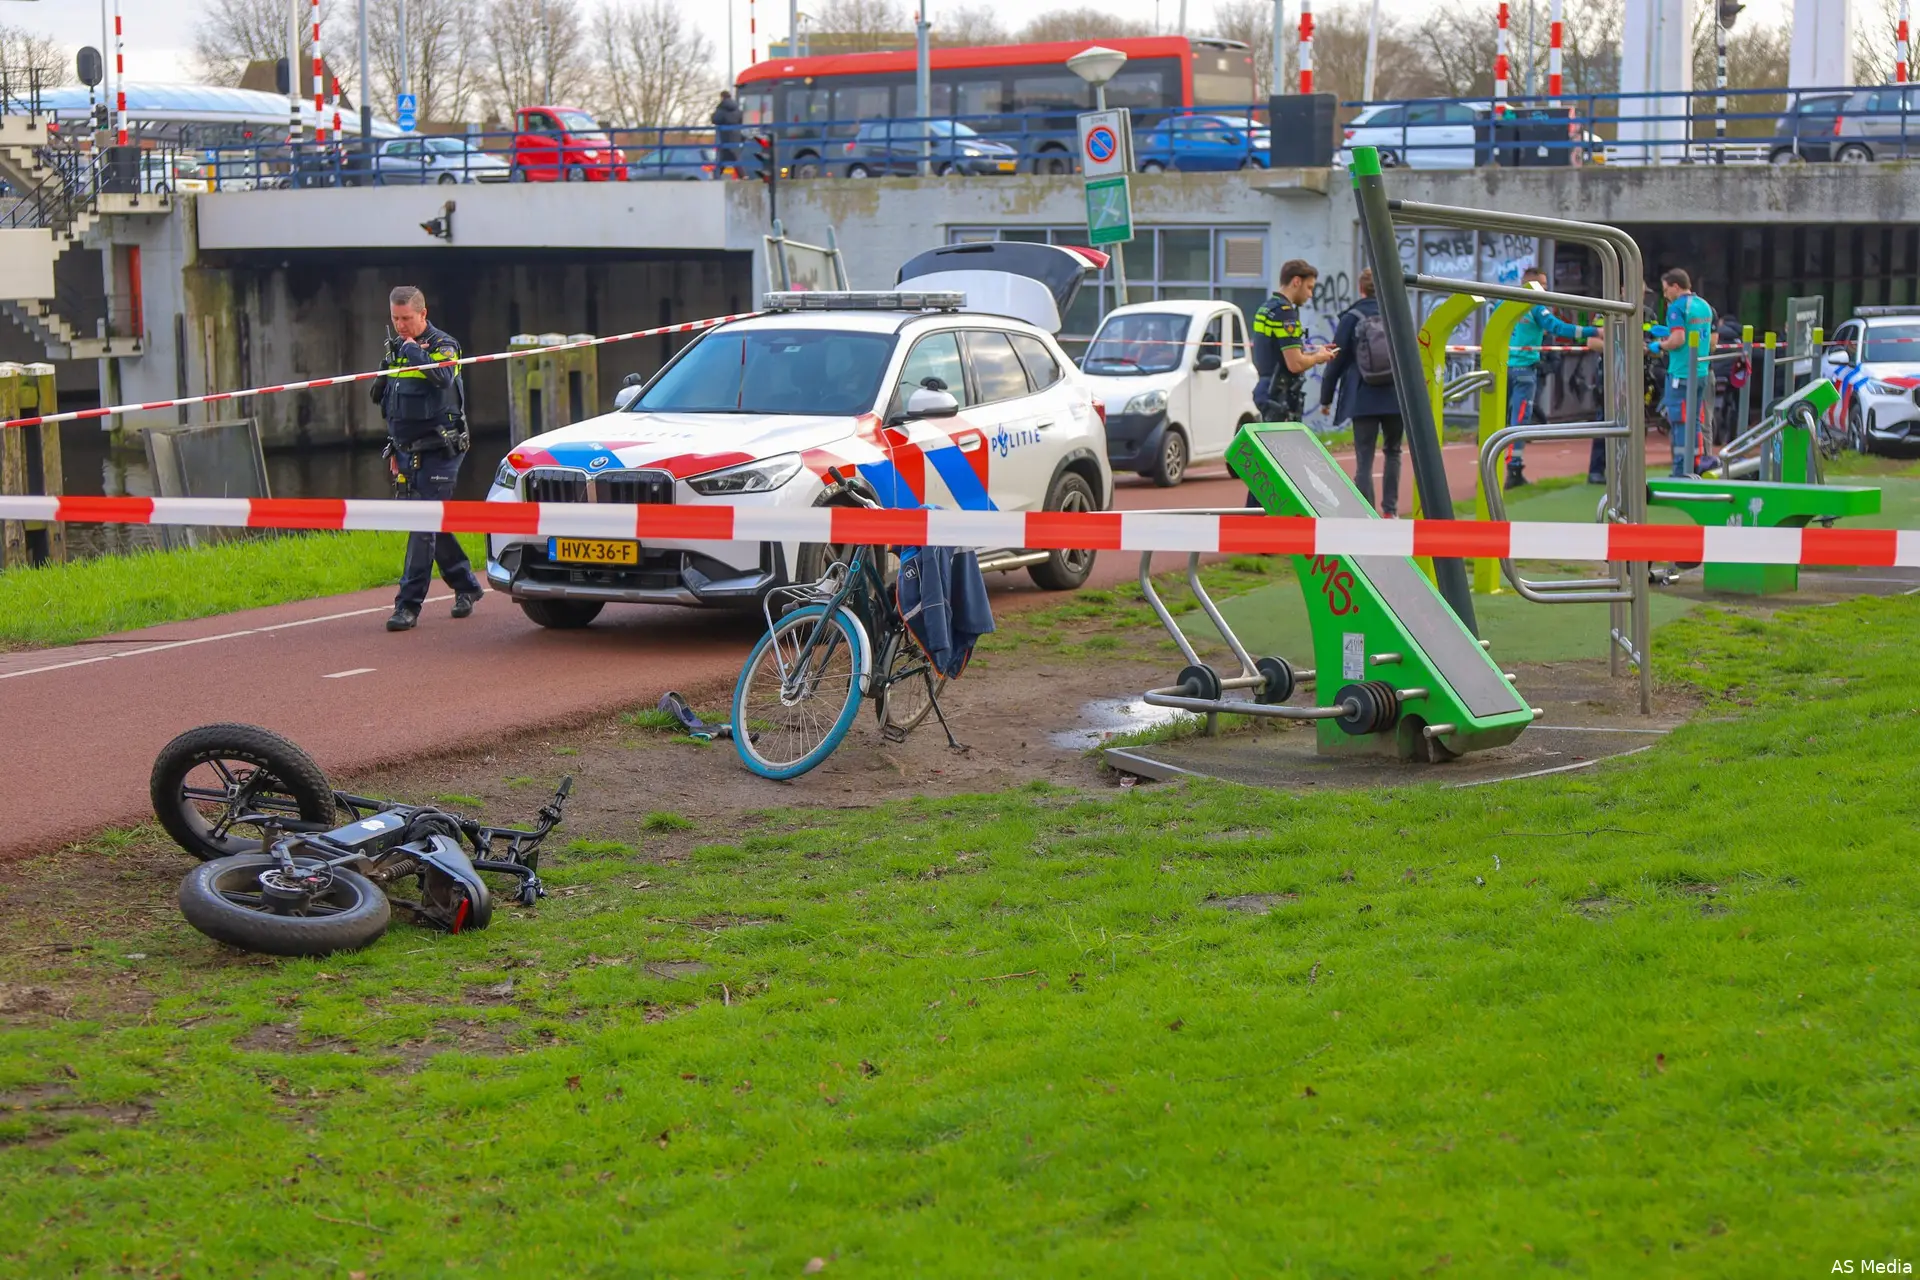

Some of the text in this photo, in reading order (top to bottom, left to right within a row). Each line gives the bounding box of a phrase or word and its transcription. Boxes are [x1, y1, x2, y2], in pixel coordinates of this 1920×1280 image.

[991, 424, 1041, 457] POLITIE
[562, 542, 631, 561] HVX-36-F
[1304, 554, 1359, 616] MS.
[193, 750, 268, 764] KENDA
